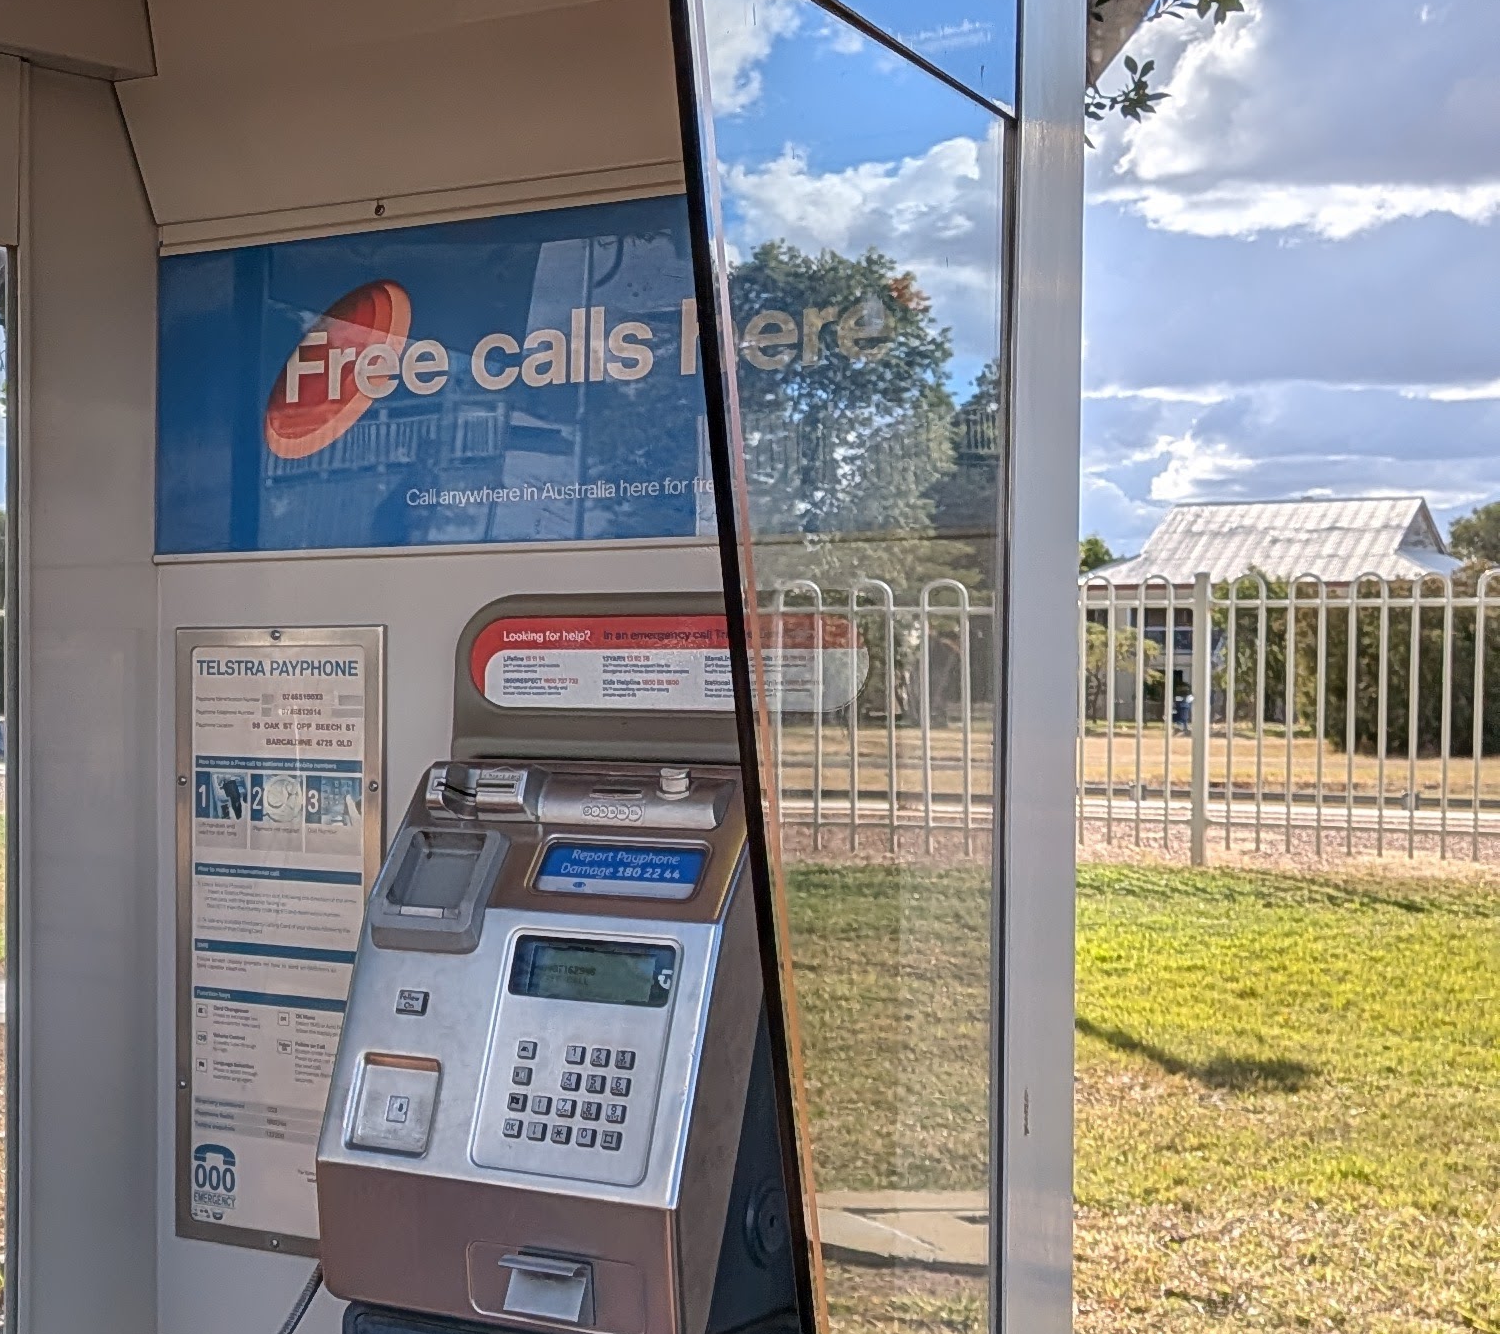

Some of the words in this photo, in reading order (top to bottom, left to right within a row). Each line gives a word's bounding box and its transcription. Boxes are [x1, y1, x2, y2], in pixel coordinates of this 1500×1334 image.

[285, 329, 450, 404] Free
[471, 305, 654, 390] calls
[406, 487, 436, 507] Call
[439, 482, 520, 508] anywhere
[523, 483, 538, 502] in
[542, 478, 616, 500] Australia
[620, 477, 660, 497] here
[664, 475, 687, 495] for
[503, 630, 544, 643] Looking
[546, 630, 560, 641] for
[562, 630, 591, 642] help?
[197, 660, 266, 677] TELSTRA
[270, 660, 359, 677] PAYPHONE
[264, 722, 280, 730] OAK
[283, 722, 293, 730] ST
[296, 722, 312, 731] OPP
[315, 723, 342, 731] BEECH
[346, 723, 356, 732] ST
[336, 738, 353, 748] QLD
[199, 784, 206, 808] 1
[252, 786, 262, 810] 2
[308, 789, 319, 813] 3
[572, 848, 613, 863] Report
[616, 851, 681, 866] Payphone
[561, 863, 613, 879] Damage
[615, 866, 639, 878] 180
[643, 867, 660, 879] 22
[663, 868, 680, 880] 44
[565, 1073, 572, 1082] 4
[590, 1075, 597, 1085] 5
[615, 1077, 622, 1088] 6
[561, 1098, 568, 1108] 7
[610, 1107, 617, 1116] 9
[506, 1121, 516, 1132] OK
[580, 1129, 588, 1139] 0
[194, 1163, 236, 1193] 000
[193, 1192, 236, 1208] EMERGENCY
